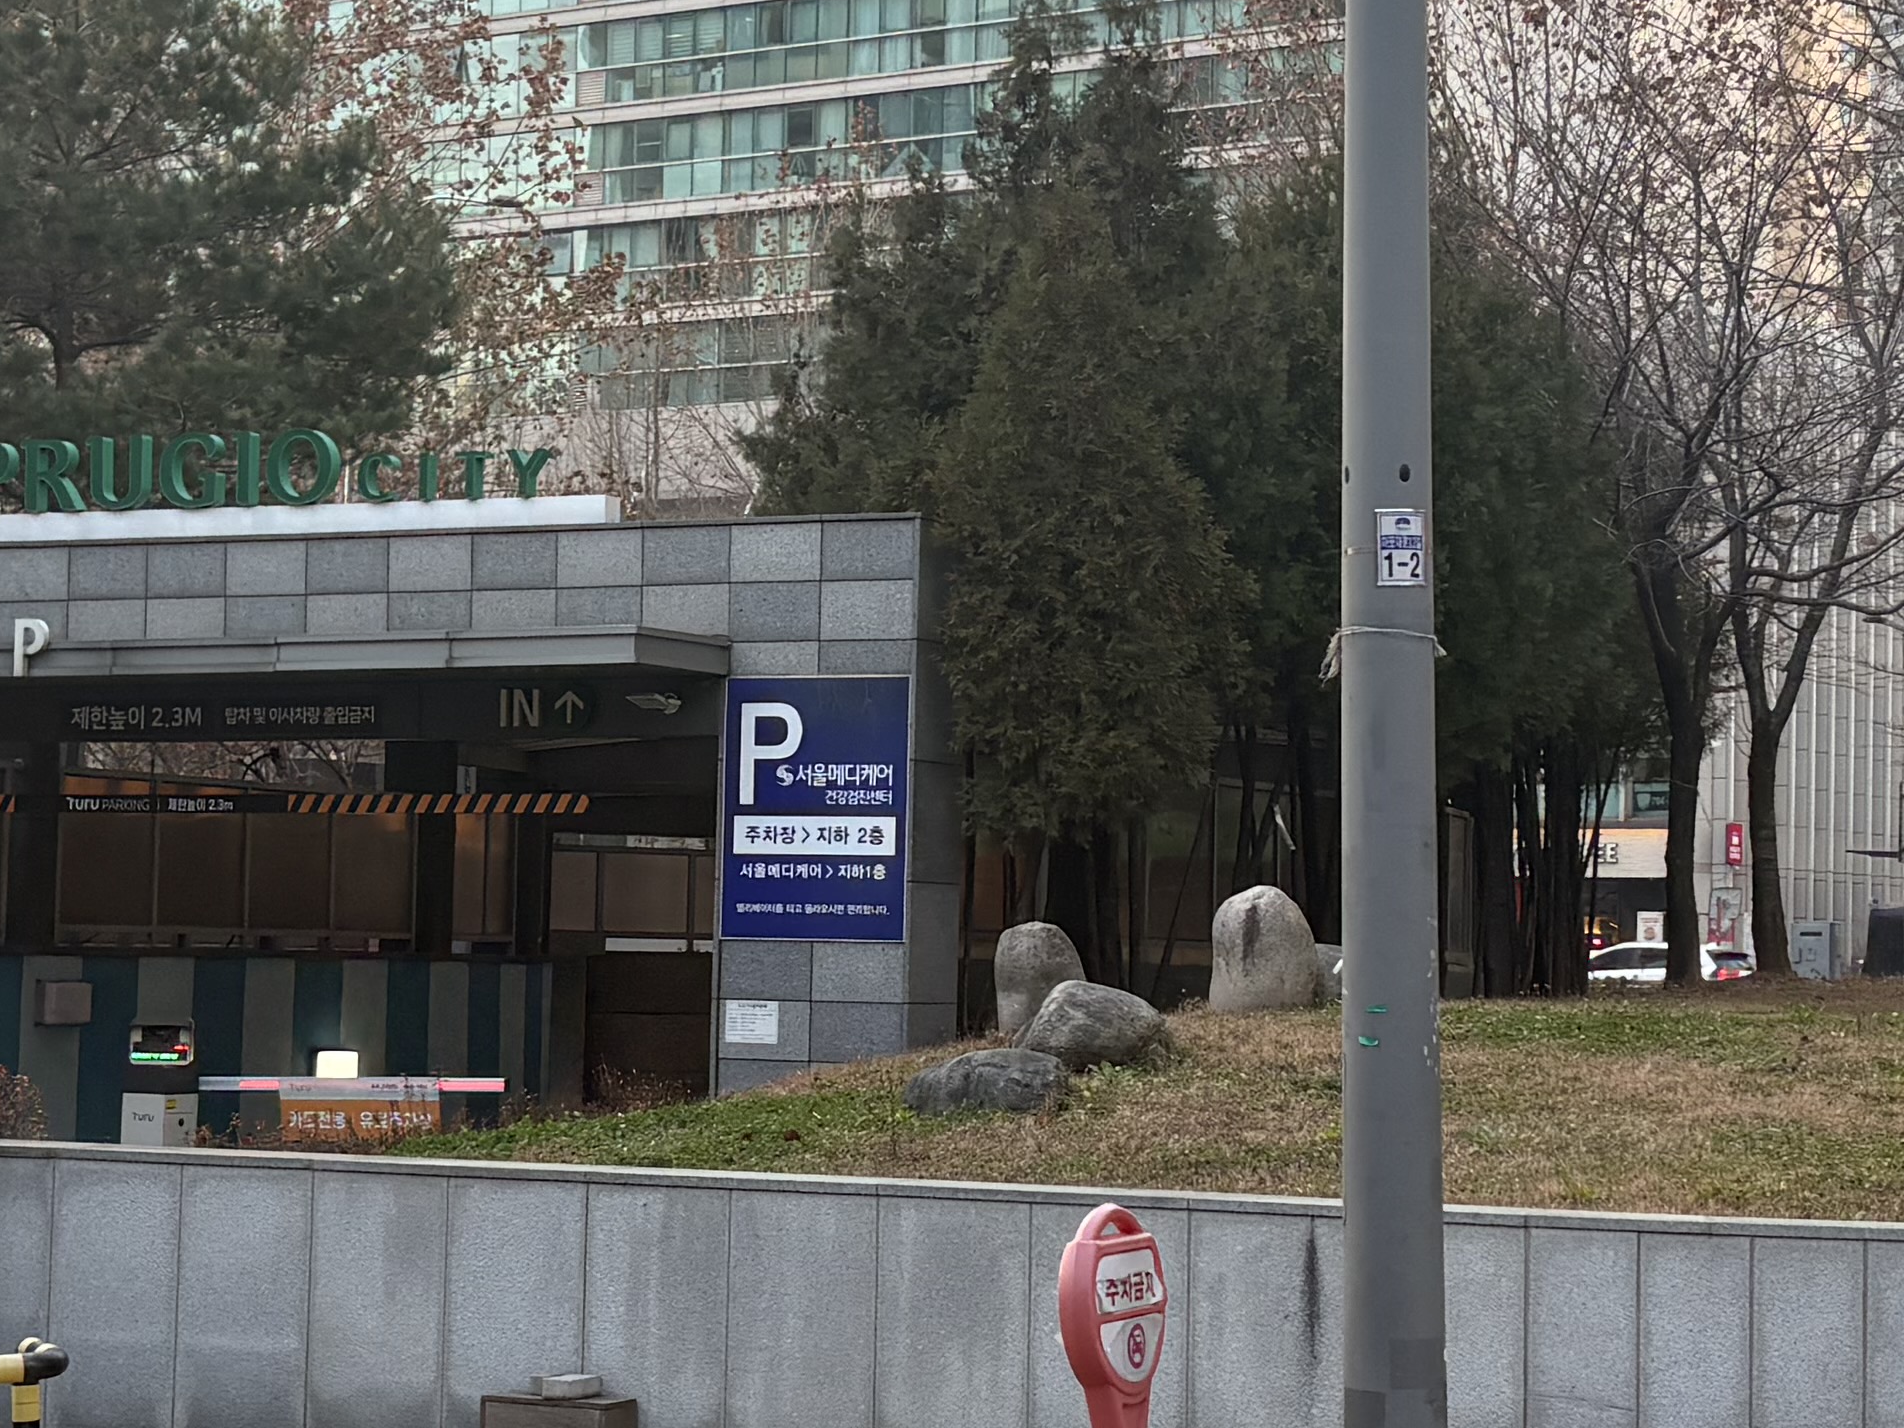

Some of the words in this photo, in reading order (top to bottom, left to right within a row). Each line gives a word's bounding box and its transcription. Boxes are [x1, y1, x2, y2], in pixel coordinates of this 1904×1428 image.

[358, 446, 557, 502] CITY
[1384, 552, 1420, 578] 1-2
[13, 618, 50, 677] P
[71, 706, 145, 730] 제한높이
[151, 706, 202, 727] 2.3M
[225, 706, 251, 724] 탑차
[254, 707, 267, 725] 및
[322, 705, 376, 724] 출입금지
[500, 688, 540, 727] IN
[739, 702, 803, 805] P
[796, 763, 894, 787] 서울메디케어
[102, 798, 150, 811] PARKING
[168, 797, 206, 812] 제한높이
[825, 789, 893, 806] 건강검진센터
[745, 825, 796, 845] 주차장
[817, 825, 849, 845] 지하
[857, 825, 885, 846] 2층
[739, 862, 822, 880] 서울메디케어
[837, 863, 887, 880] 지하1층
